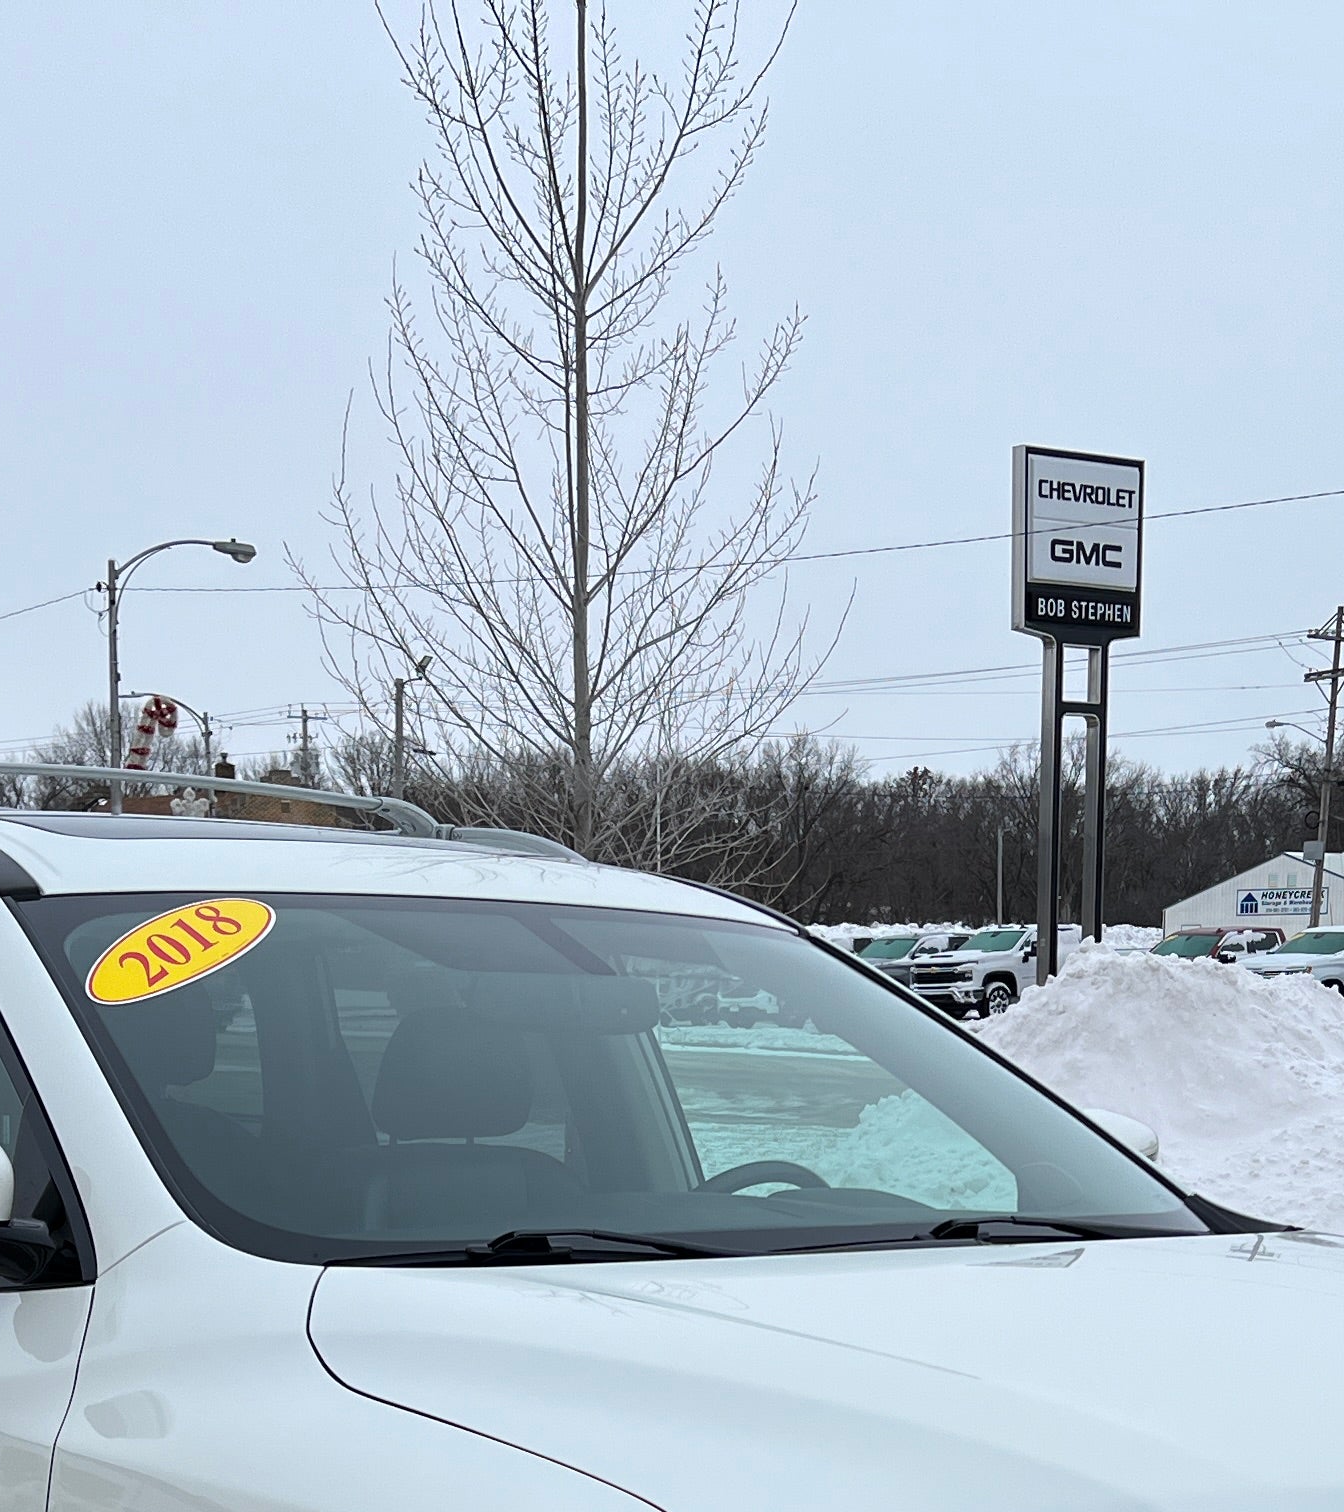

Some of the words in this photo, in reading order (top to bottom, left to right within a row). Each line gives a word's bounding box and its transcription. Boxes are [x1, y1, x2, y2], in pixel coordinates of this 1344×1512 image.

[1037, 479, 1136, 508] CHEVROLET
[1050, 538, 1123, 569] GMC
[1037, 597, 1065, 618] BOB
[1071, 600, 1131, 623] STEPHEN
[1260, 890, 1325, 900] HONEYCREK
[118, 905, 242, 987] 2018
